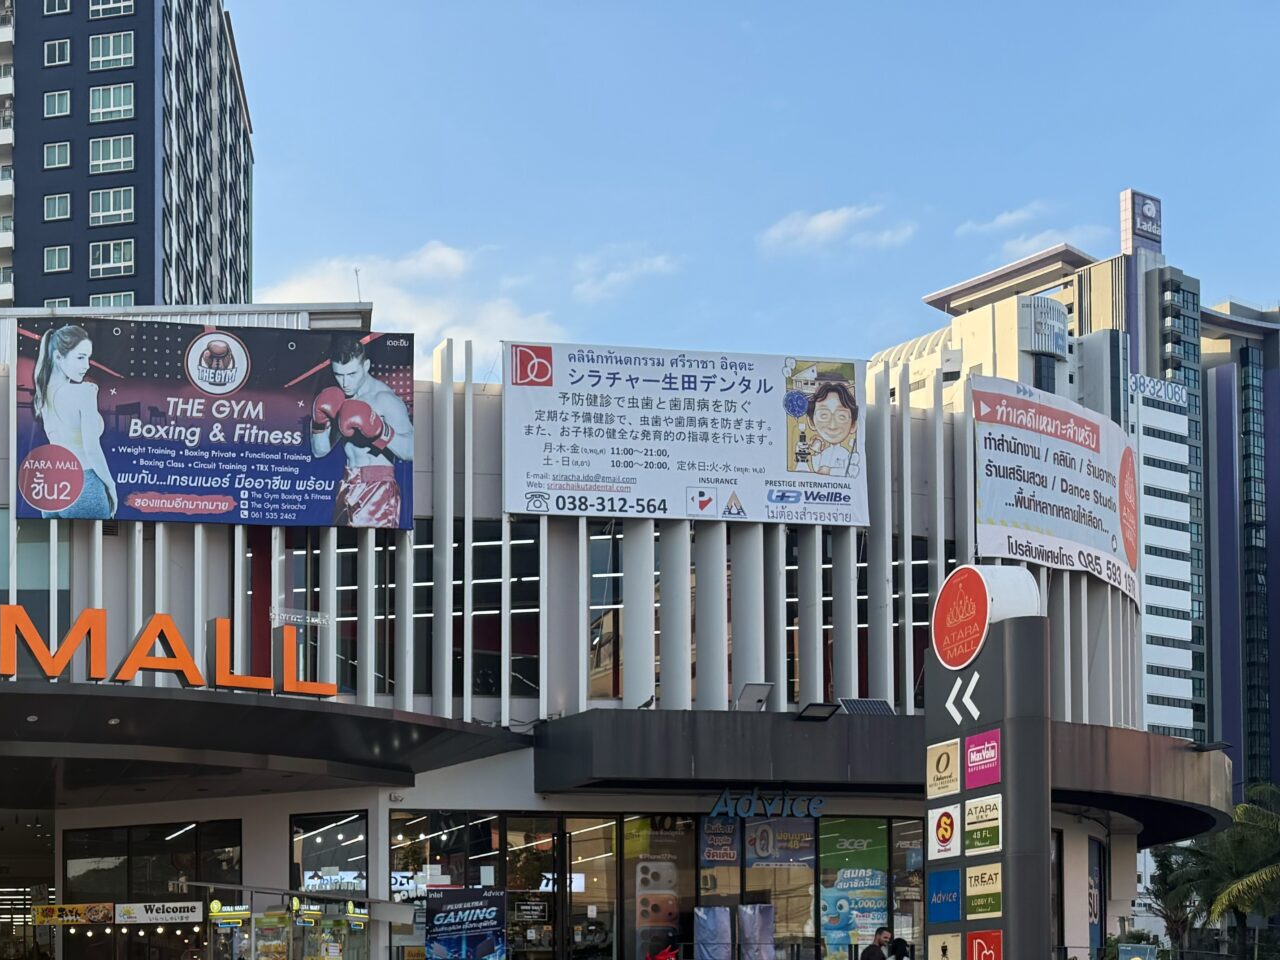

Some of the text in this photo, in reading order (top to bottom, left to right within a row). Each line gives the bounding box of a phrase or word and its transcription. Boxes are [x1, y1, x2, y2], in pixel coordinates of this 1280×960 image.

[567, 351, 755, 375] คลินิกทันตกรรม ศรีราชา อิคุตะ
[568, 368, 775, 395] シラチャー生田デンタル
[166, 397, 265, 420] THE GYM
[558, 391, 752, 415] 予防健診で虫歯と歯周病を防ぐ
[128, 418, 303, 447] Boxing & Fitness
[117, 445, 176, 458] Weight Training
[183, 449, 237, 459] Boxing Private
[245, 451, 312, 463] Functional Training
[983, 431, 1041, 460] ทำสำนักงาน
[1053, 450, 1077, 470] คลินิก
[23, 460, 79, 471] ATARA MALL
[139, 458, 185, 468] Boxing Class
[193, 461, 248, 472] Circuit Training
[256, 464, 300, 475] TRX Training
[234, 473, 291, 491] มืออาชีพ
[296, 475, 335, 491] พร้อม
[525, 472, 551, 481] E-mail:
[698, 477, 738, 486] INSURANCE
[526, 481, 546, 489] Web:
[764, 479, 852, 490] PRESTIGE INTERNATIONAL
[984, 458, 1117, 514] ร้านเสริมสวย Dance Studio
[250, 491, 263, 499] The
[263, 492, 279, 501] Gym
[804, 490, 852, 503] WellBe
[134, 496, 229, 511] ของแถมอีกมากมาย
[250, 501, 263, 509] The
[263, 502, 279, 511] Gym
[554, 495, 669, 515] 038-312-564
[250, 511, 297, 520] 061 535 2462
[764, 504, 852, 523] ไม่ต้องสำรองจ่าย
[1006, 535, 1075, 568] โปรลับพิเศษโทร
[1077, 550, 1103, 576] 085
[1106, 563, 1122, 587] 593
[942, 623, 980, 648] ATARA
[946, 639, 977, 660] MALL
[970, 743, 995, 763] MaxValu
[710, 787, 826, 818] Advice
[967, 803, 999, 816] ATARA
[835, 838, 872, 849] acer
[968, 872, 999, 887] TREAT
[429, 891, 444, 899] intel
[482, 890, 505, 898] Advice
[931, 890, 958, 905] Advice
[143, 904, 197, 915] Welcome
[433, 906, 498, 925] GAMING
